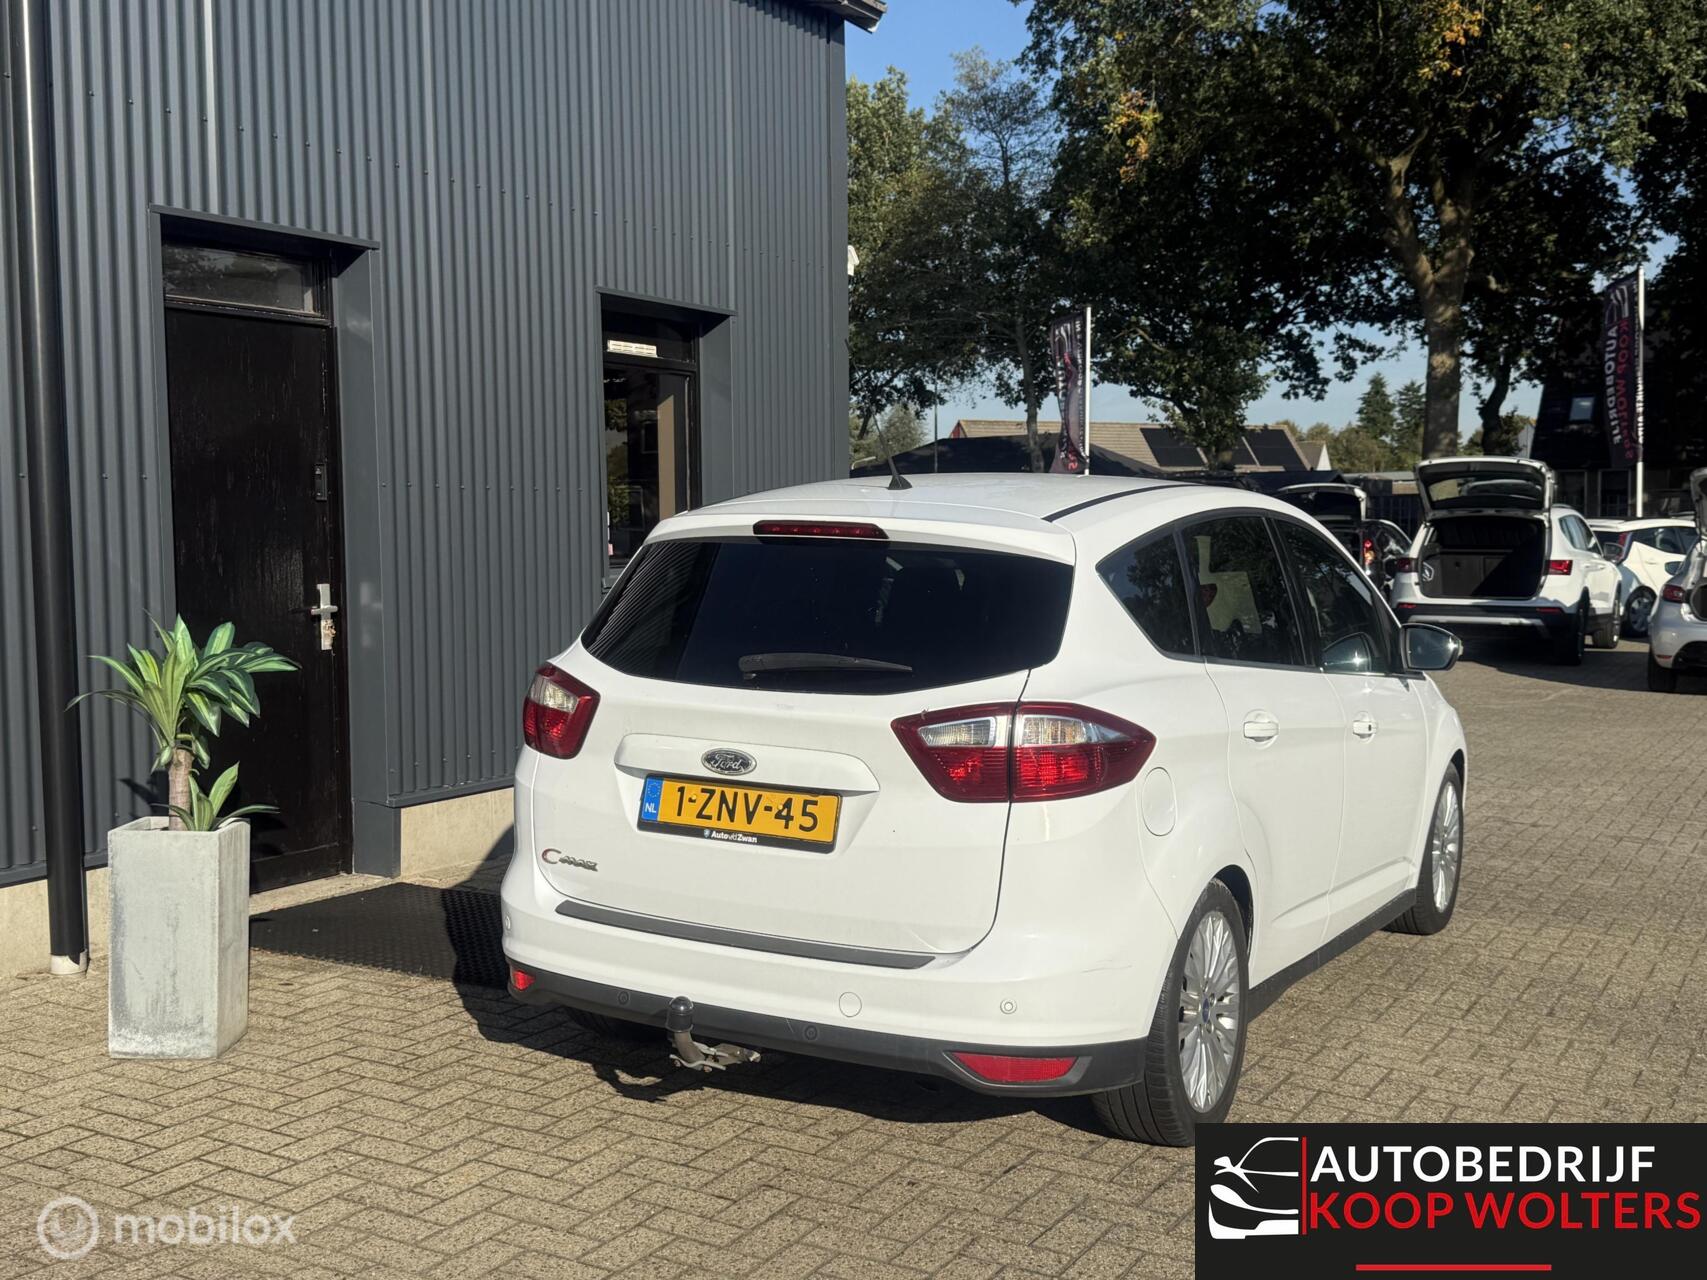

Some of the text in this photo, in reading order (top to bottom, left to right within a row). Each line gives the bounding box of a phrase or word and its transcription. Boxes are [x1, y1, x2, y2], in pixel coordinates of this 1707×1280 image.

[711, 753, 745, 772] Ford
[644, 803, 657, 814] NL
[675, 786, 819, 832] 1-ZNV-45
